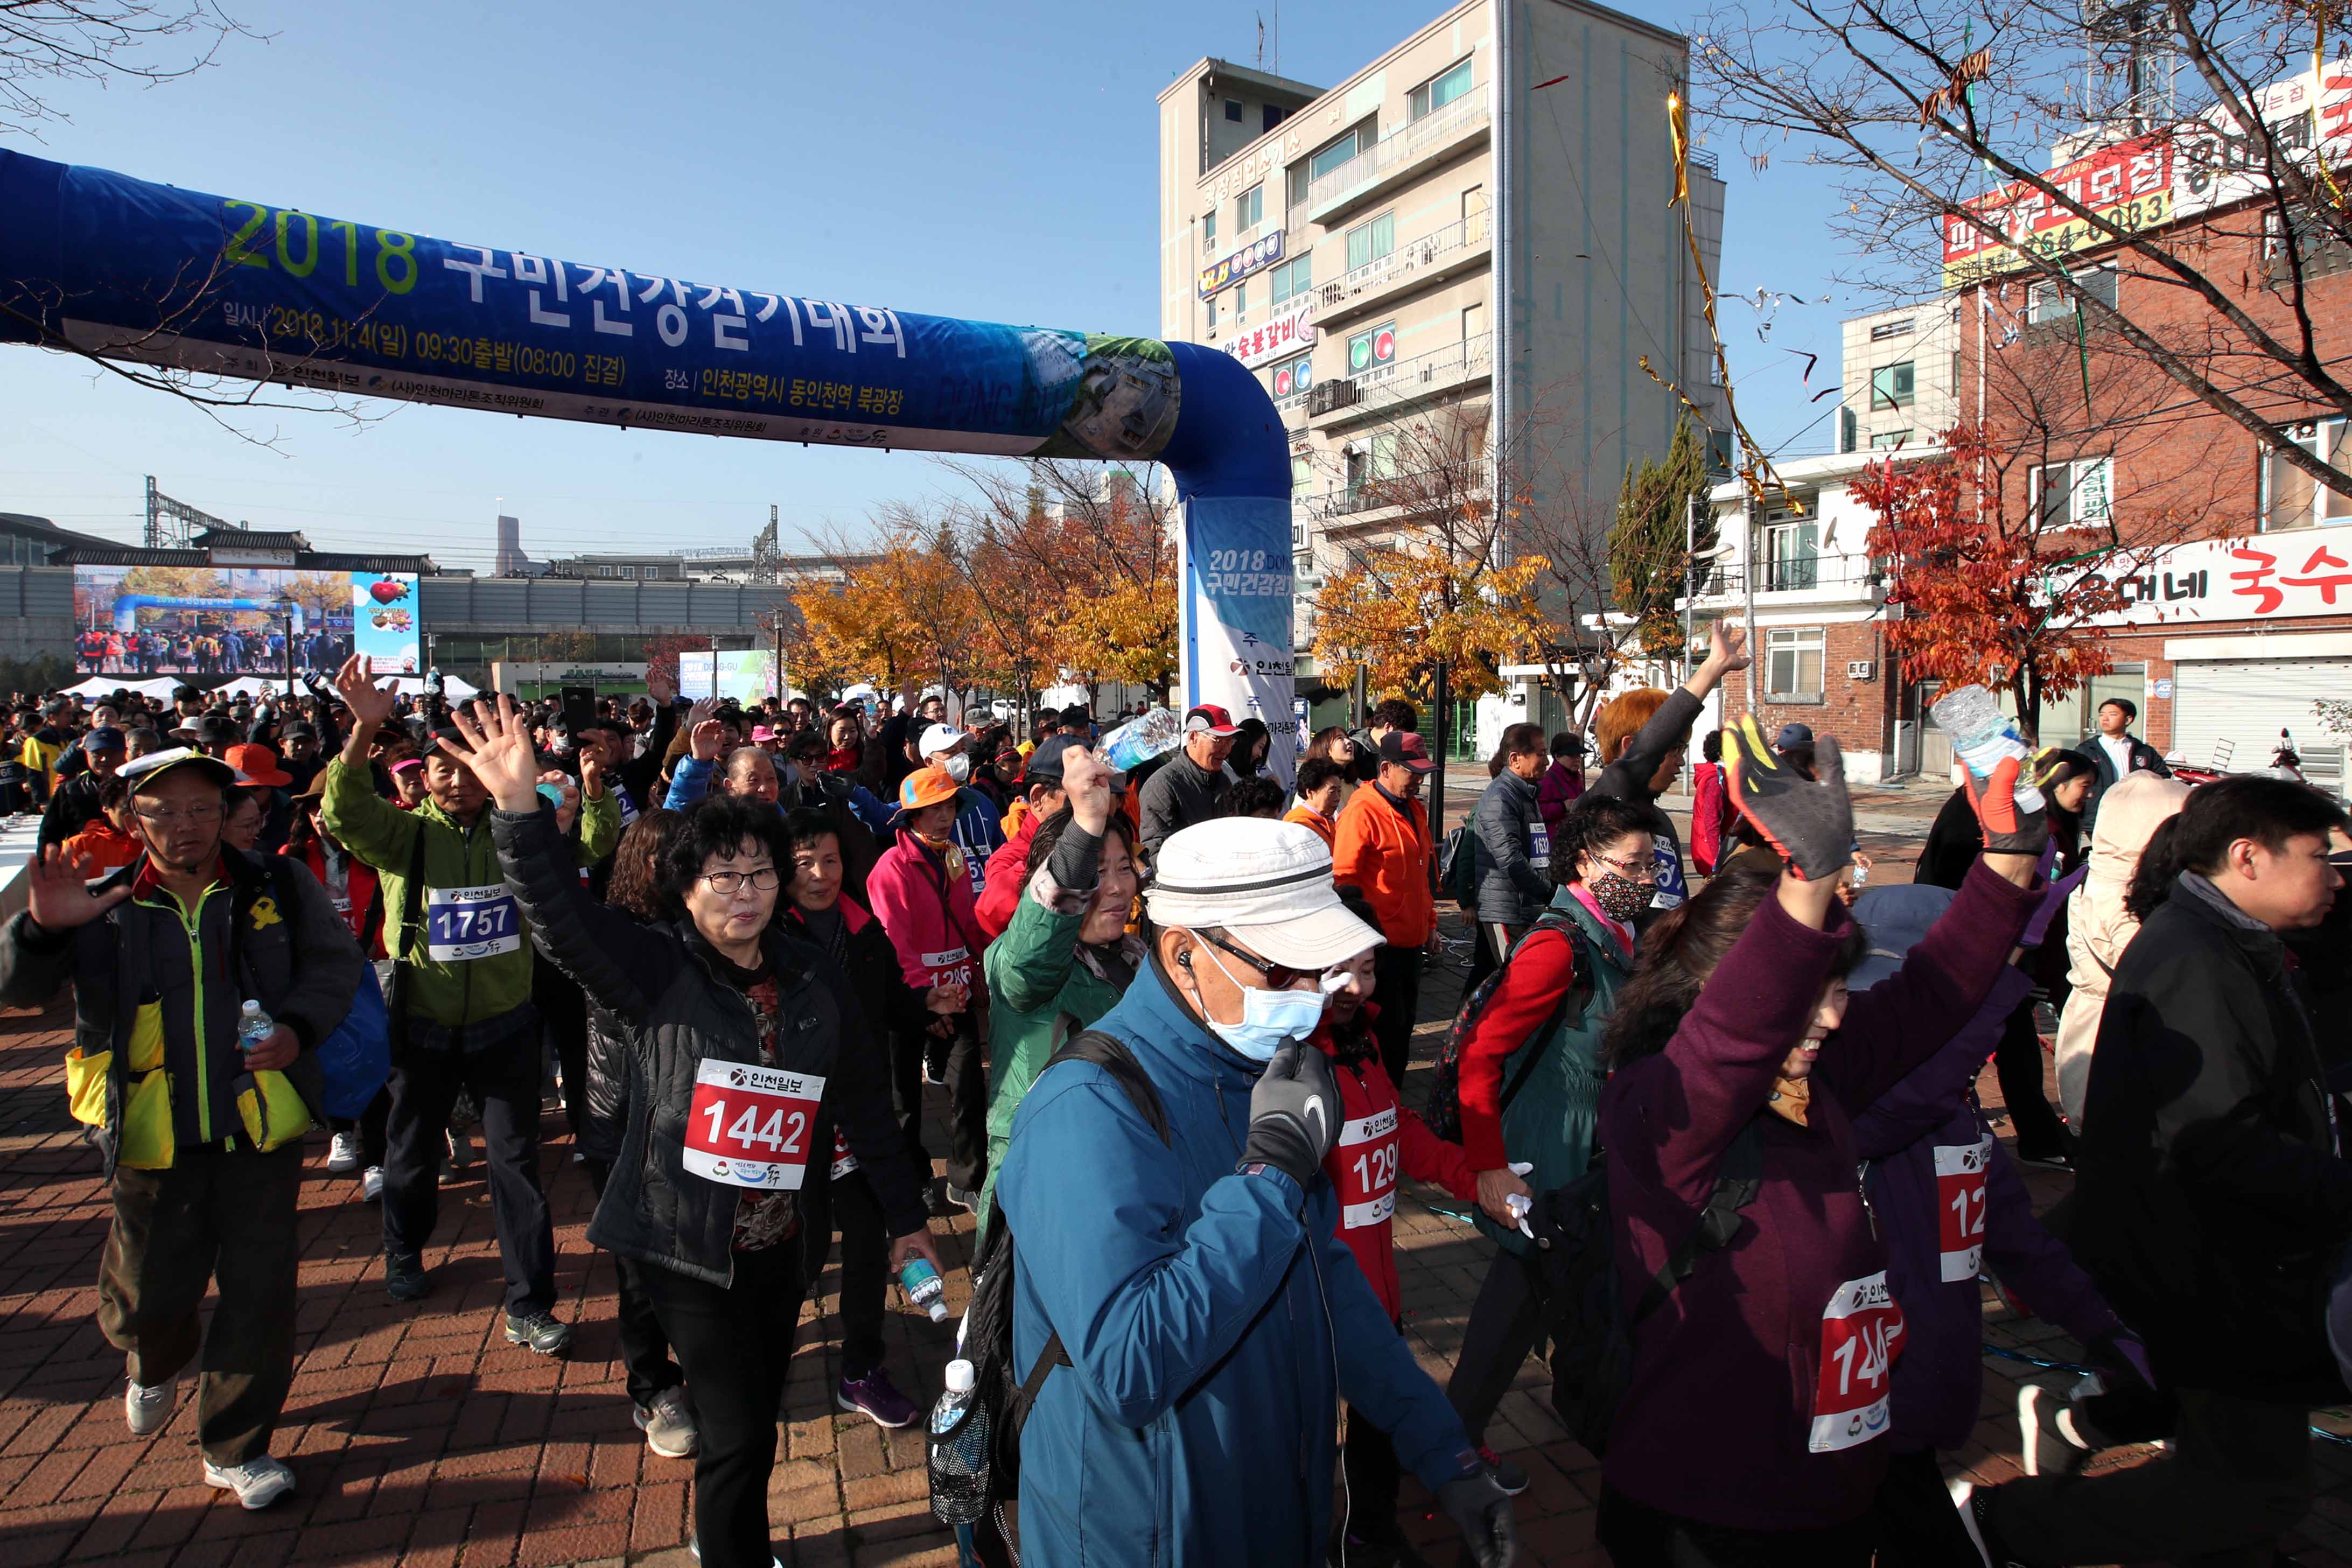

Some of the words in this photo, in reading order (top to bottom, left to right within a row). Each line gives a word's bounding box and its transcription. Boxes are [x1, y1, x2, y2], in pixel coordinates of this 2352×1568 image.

[223, 200, 417, 295] 2018
[443, 242, 906, 358] 구민건강걷기대회
[294, 367, 360, 387] 인천일보
[664, 368, 689, 391] 장소
[703, 368, 785, 401] 인천광역시
[790, 377, 853, 409] 동인천역
[857, 385, 904, 416] 북광장
[1209, 549, 1265, 571] 2018
[2230, 545, 2352, 614] 국수
[1256, 660, 1294, 676] 인천일
[464, 888, 501, 900] 인천일보
[437, 905, 508, 939] 1757
[750, 1072, 803, 1094] 인천일보
[703, 1100, 806, 1154] 1442
[1353, 1137, 1399, 1194] 129
